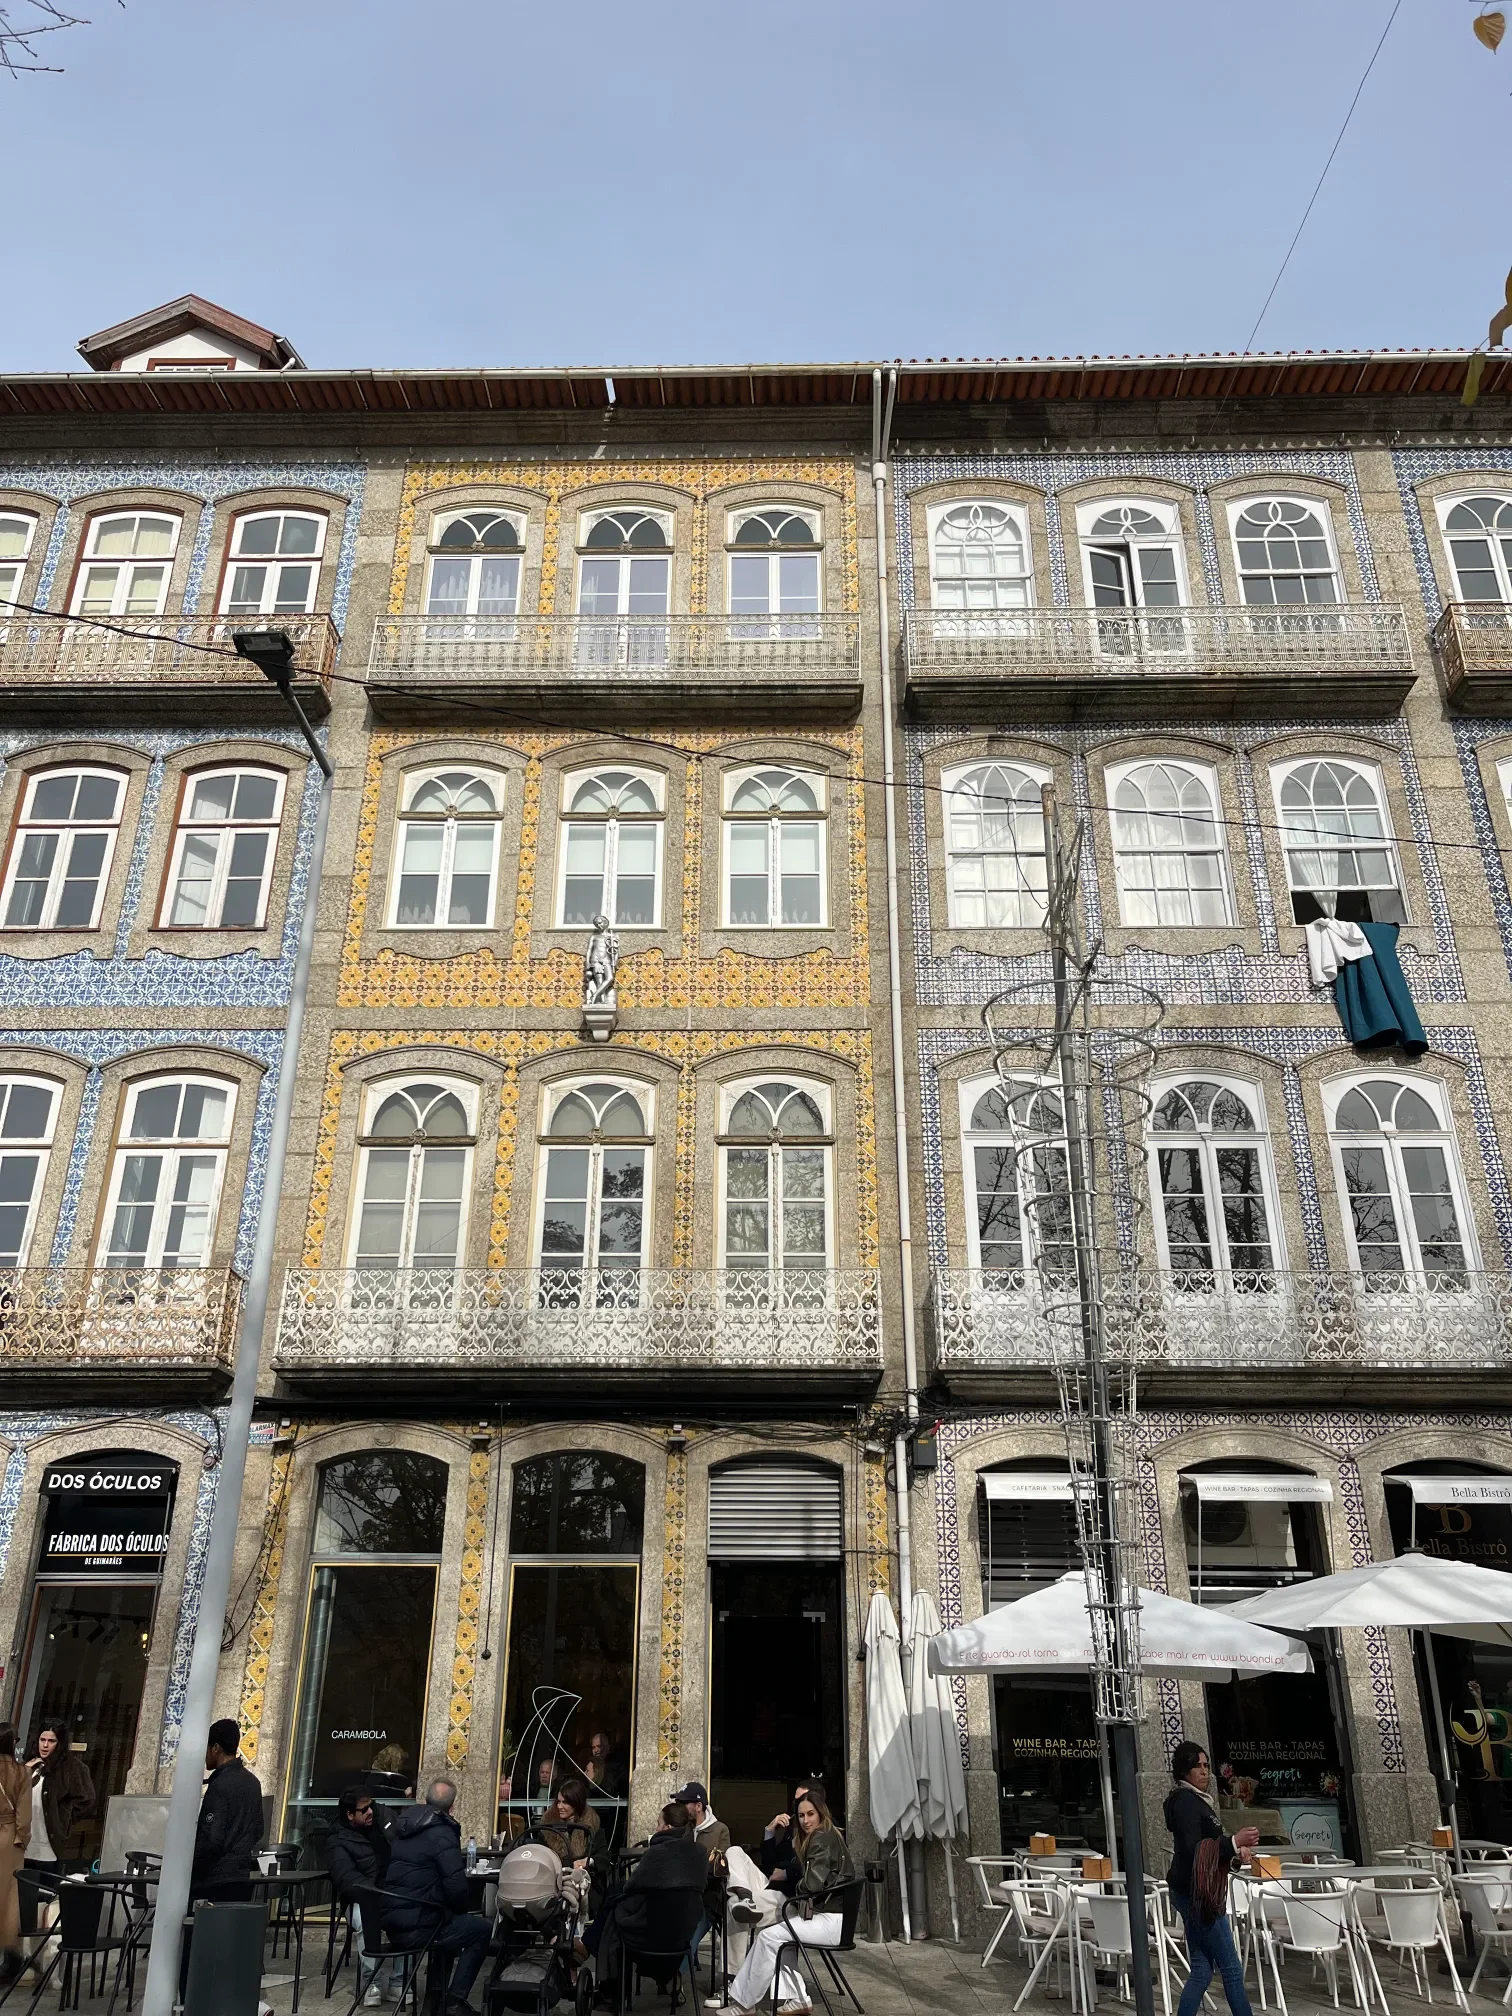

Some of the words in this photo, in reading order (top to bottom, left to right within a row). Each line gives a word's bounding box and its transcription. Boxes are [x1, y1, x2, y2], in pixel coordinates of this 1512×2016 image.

[48, 1474, 86, 1489] DOS
[89, 1471, 162, 1490] ÓCULOS
[1451, 1487, 1478, 1498] Bella
[1480, 1487, 1511, 1498] Bistrô
[48, 1531, 98, 1552] FÁBRICA
[99, 1534, 124, 1552] DOS
[125, 1531, 170, 1552] ÓCULOS
[1456, 1538, 1507, 1555] Bistrô
[84, 1557, 92, 1565] DE
[959, 1651, 978, 1660] Este
[1033, 1649, 1059, 1657] torna
[1167, 1651, 1189, 1659] mais
[331, 1730, 387, 1739] CARAMBOLA
[1012, 1738, 1042, 1748] WINE
[1044, 1739, 1067, 1748] BAR
[1226, 1741, 1257, 1750] WINE
[1259, 1741, 1282, 1750] BAR
[1291, 1741, 1325, 1750] TAPAS
[1014, 1748, 1059, 1758] COZINHA
[1060, 1748, 1110, 1759] REGION
[1229, 1751, 1274, 1760] COZINHA
[1276, 1751, 1327, 1760] REGIONAL
[1259, 1767, 1302, 1787] Segreti
[1294, 1829, 1331, 1845] Segreti
